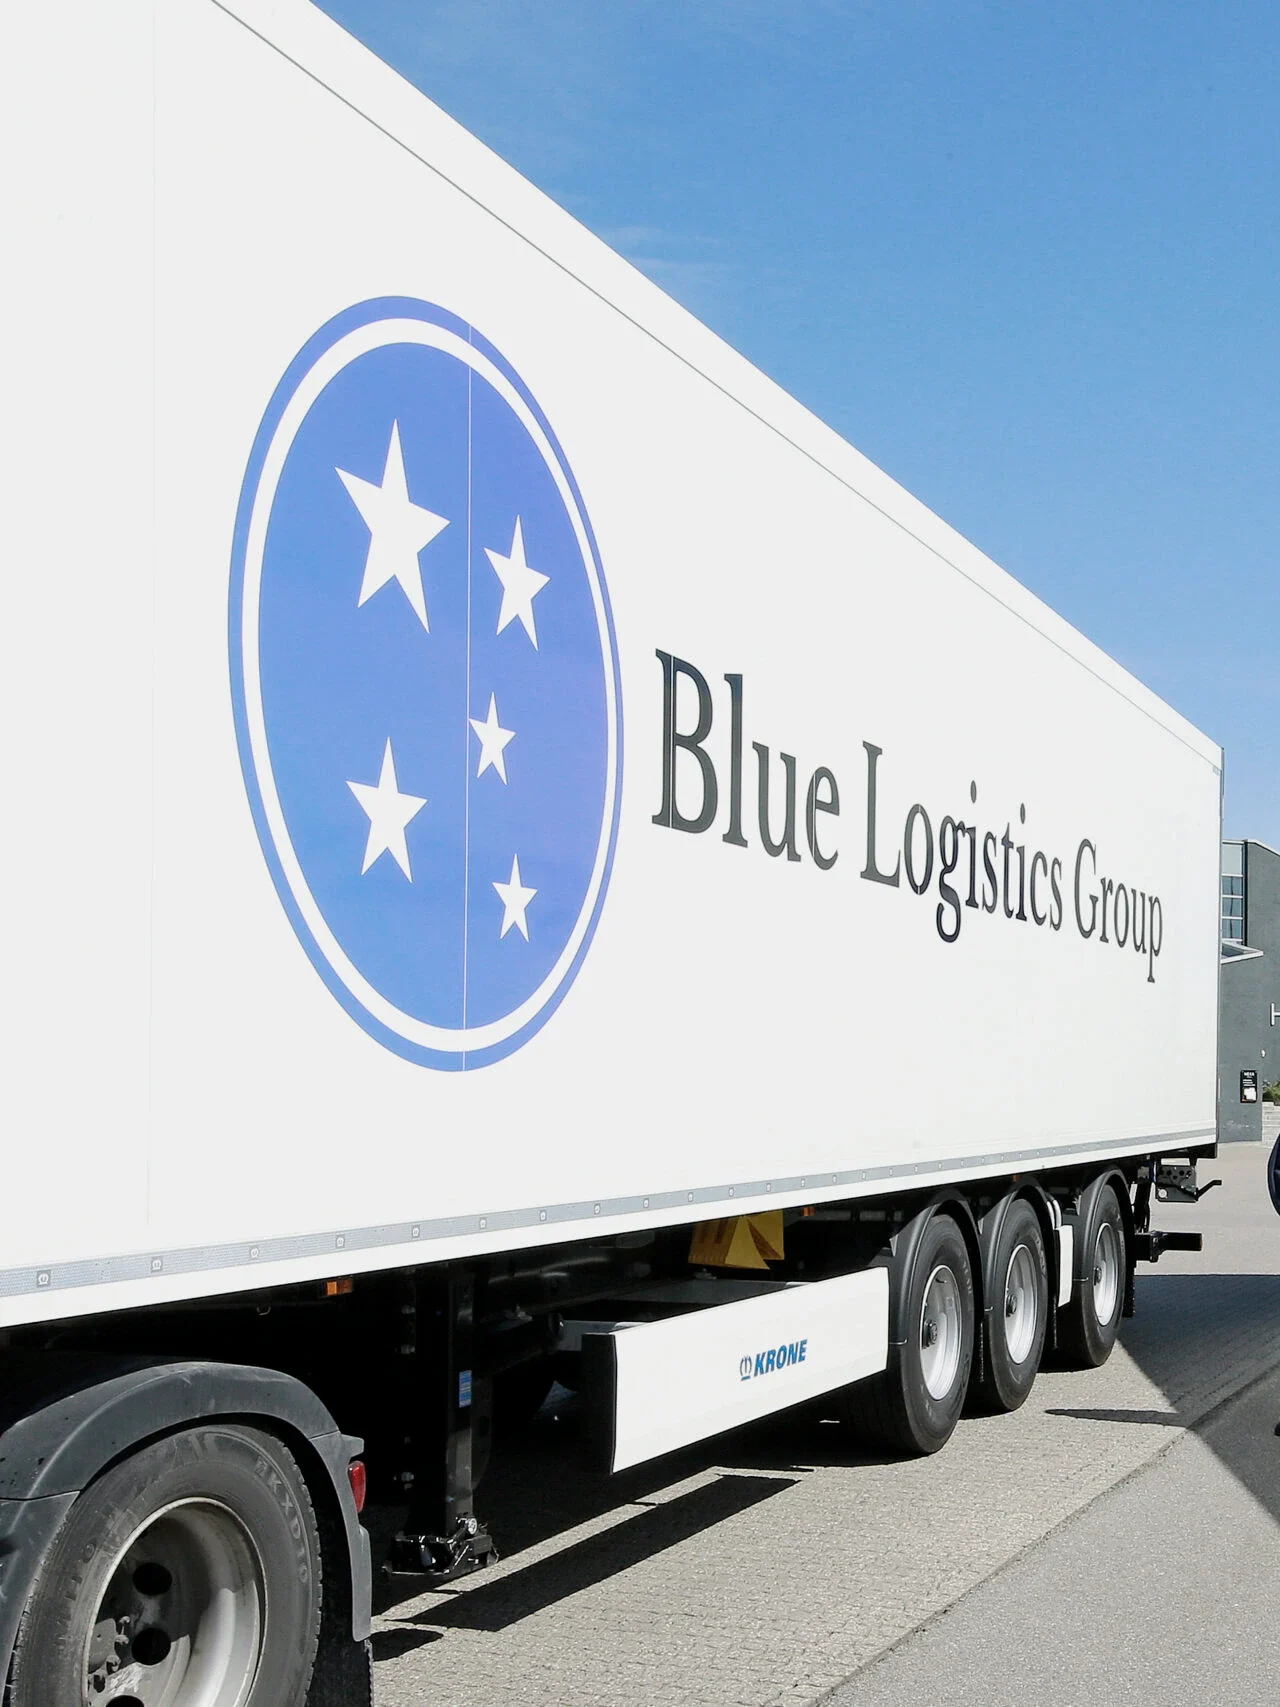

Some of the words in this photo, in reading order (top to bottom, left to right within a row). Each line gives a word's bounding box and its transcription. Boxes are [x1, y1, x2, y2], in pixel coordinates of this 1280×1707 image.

[651, 648, 840, 870] Blue
[859, 740, 1063, 944] Logistics
[1073, 838, 1163, 984] Group
[753, 1339, 808, 1377] KRONE
